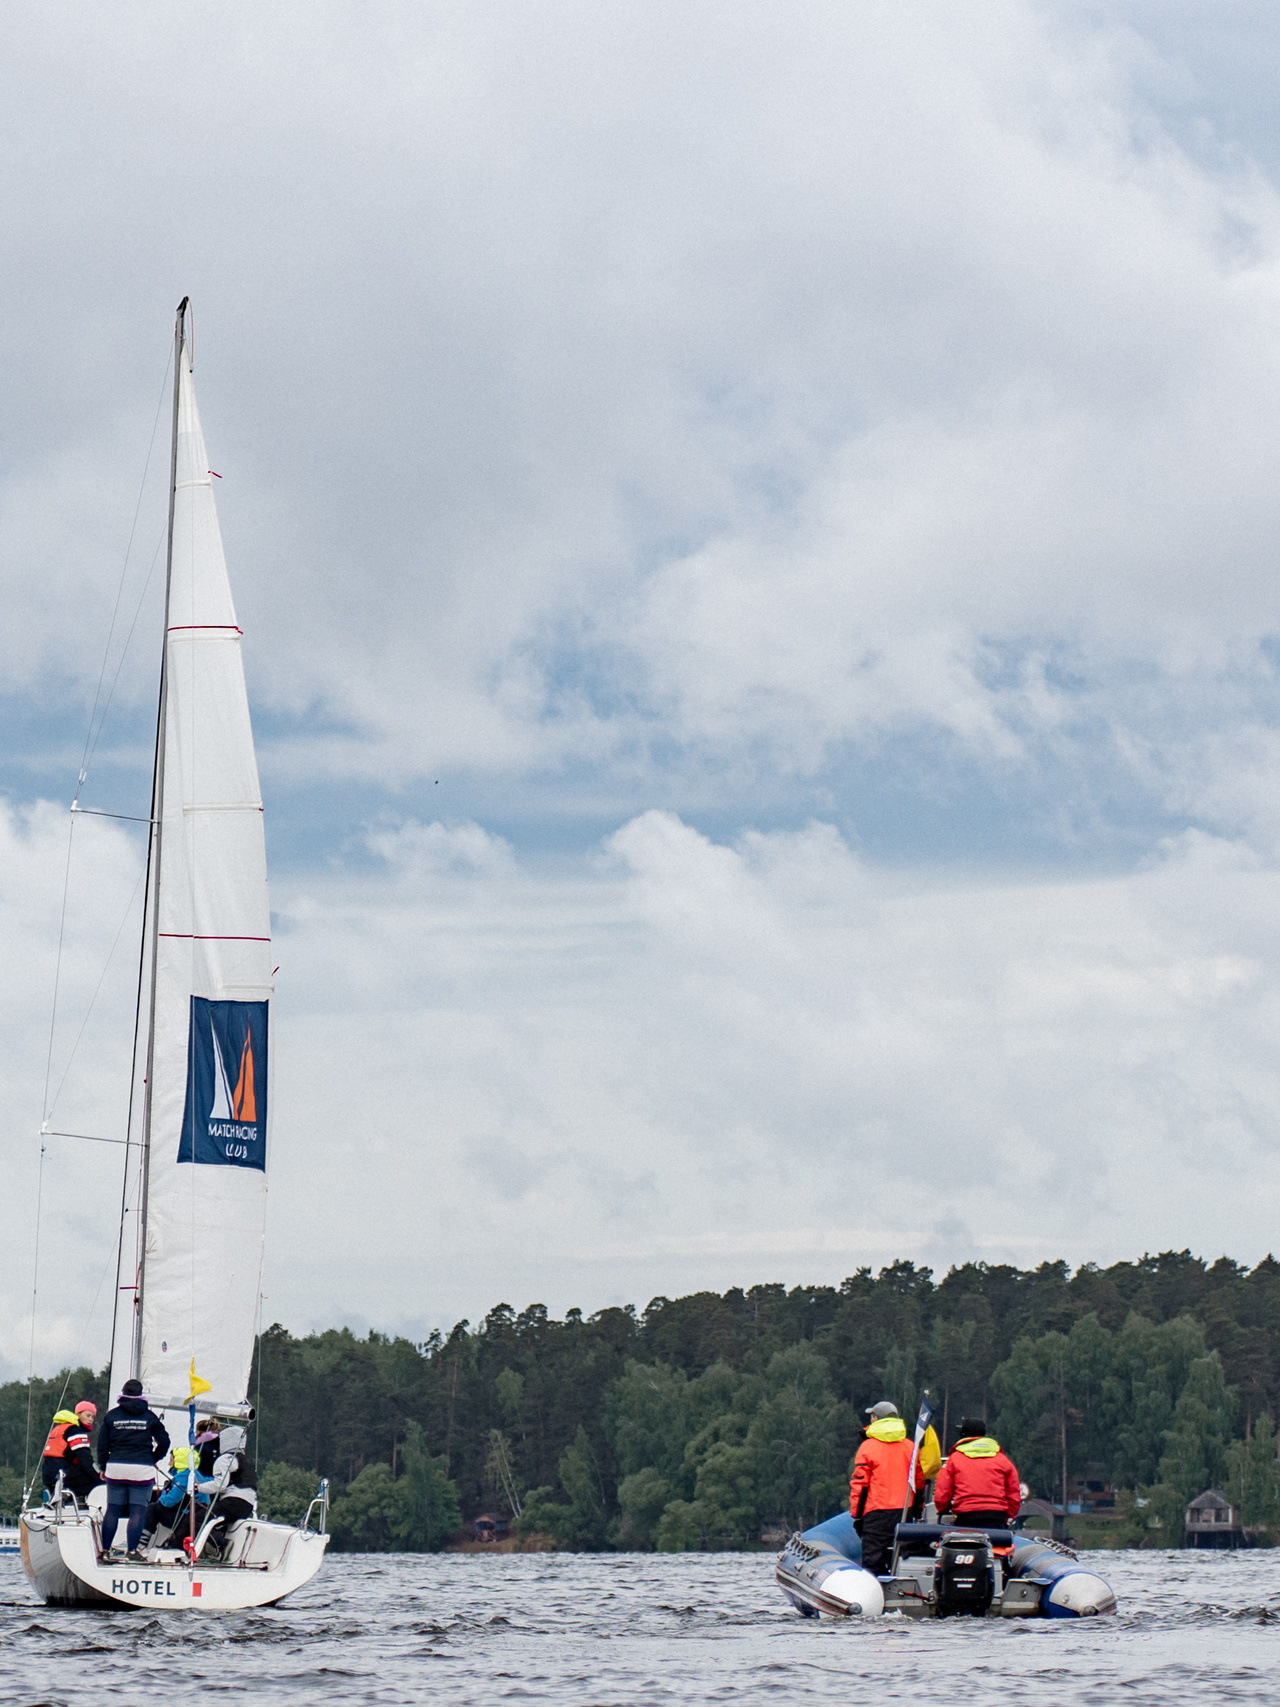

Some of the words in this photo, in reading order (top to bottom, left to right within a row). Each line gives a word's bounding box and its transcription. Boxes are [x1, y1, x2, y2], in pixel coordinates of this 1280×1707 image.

[208, 1122, 235, 1138] MATCH
[954, 1554, 975, 1565] 90
[111, 1579, 176, 1596] HOTEL
